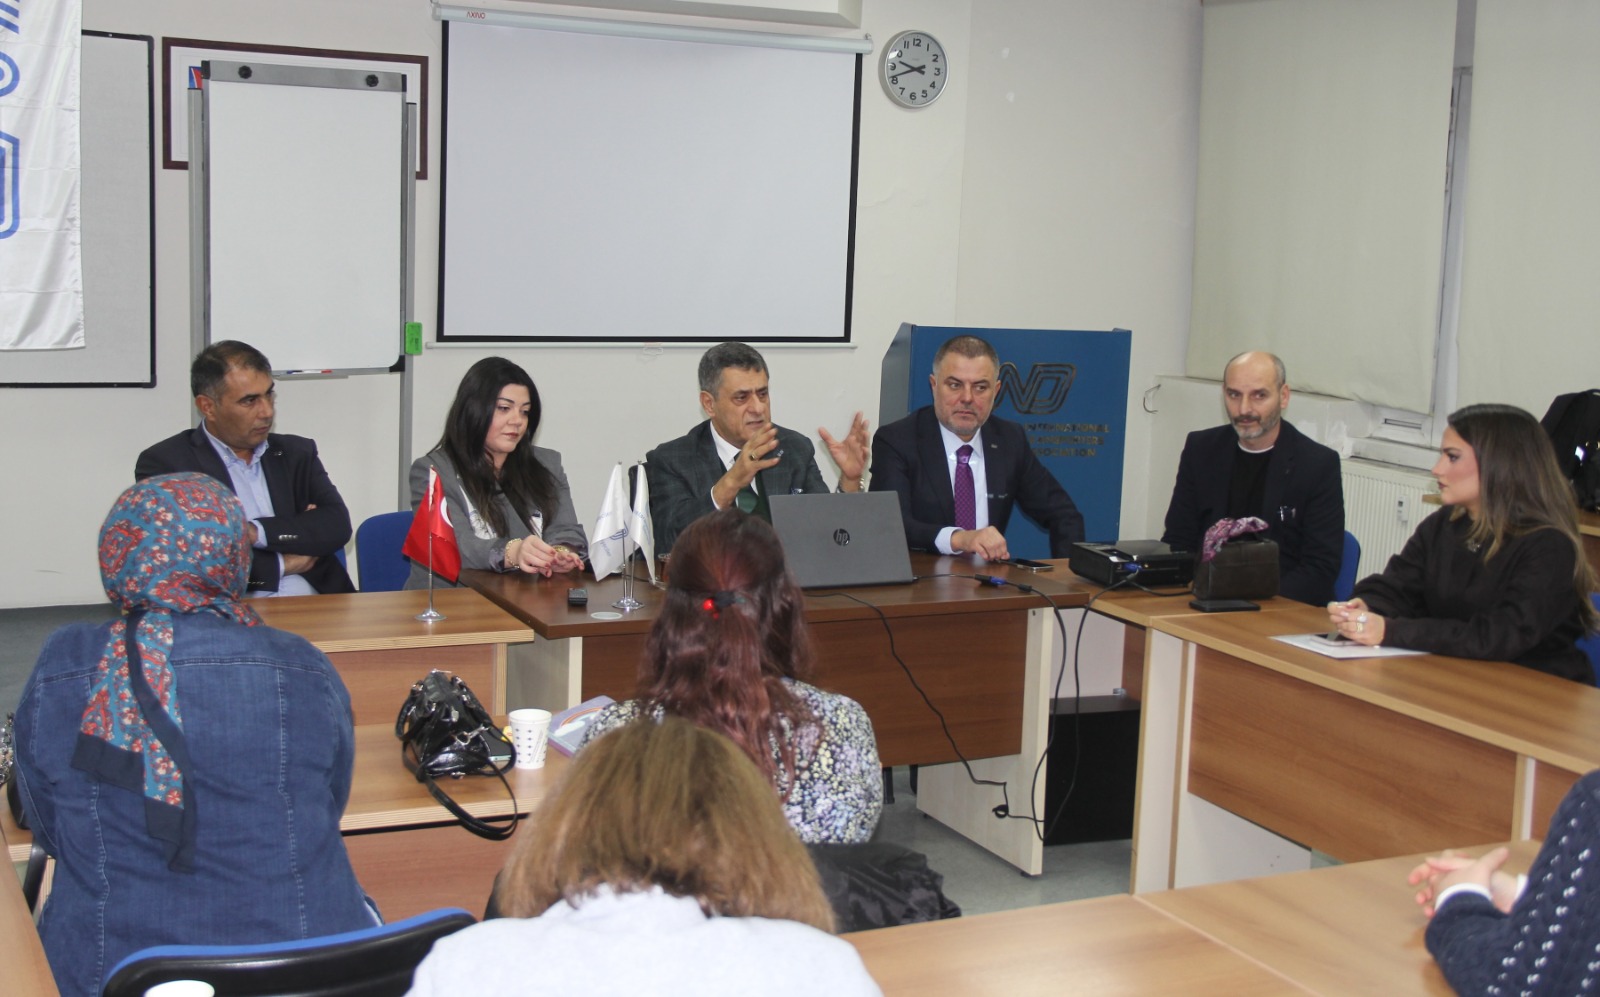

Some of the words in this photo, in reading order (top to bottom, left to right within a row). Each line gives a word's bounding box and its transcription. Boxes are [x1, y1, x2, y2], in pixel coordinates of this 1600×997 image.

[903, 40, 910, 49] 11
[912, 38, 922, 47] 12
[932, 53, 939, 62] 2
[934, 67, 941, 76] 3
[891, 76, 899, 85] 8
[929, 81, 936, 89] 4
[899, 87, 906, 95] 7
[921, 89, 928, 98] 5
[909, 92, 917, 100] 6
[994, 362, 1077, 415] ND
[833, 528, 850, 546] hp
